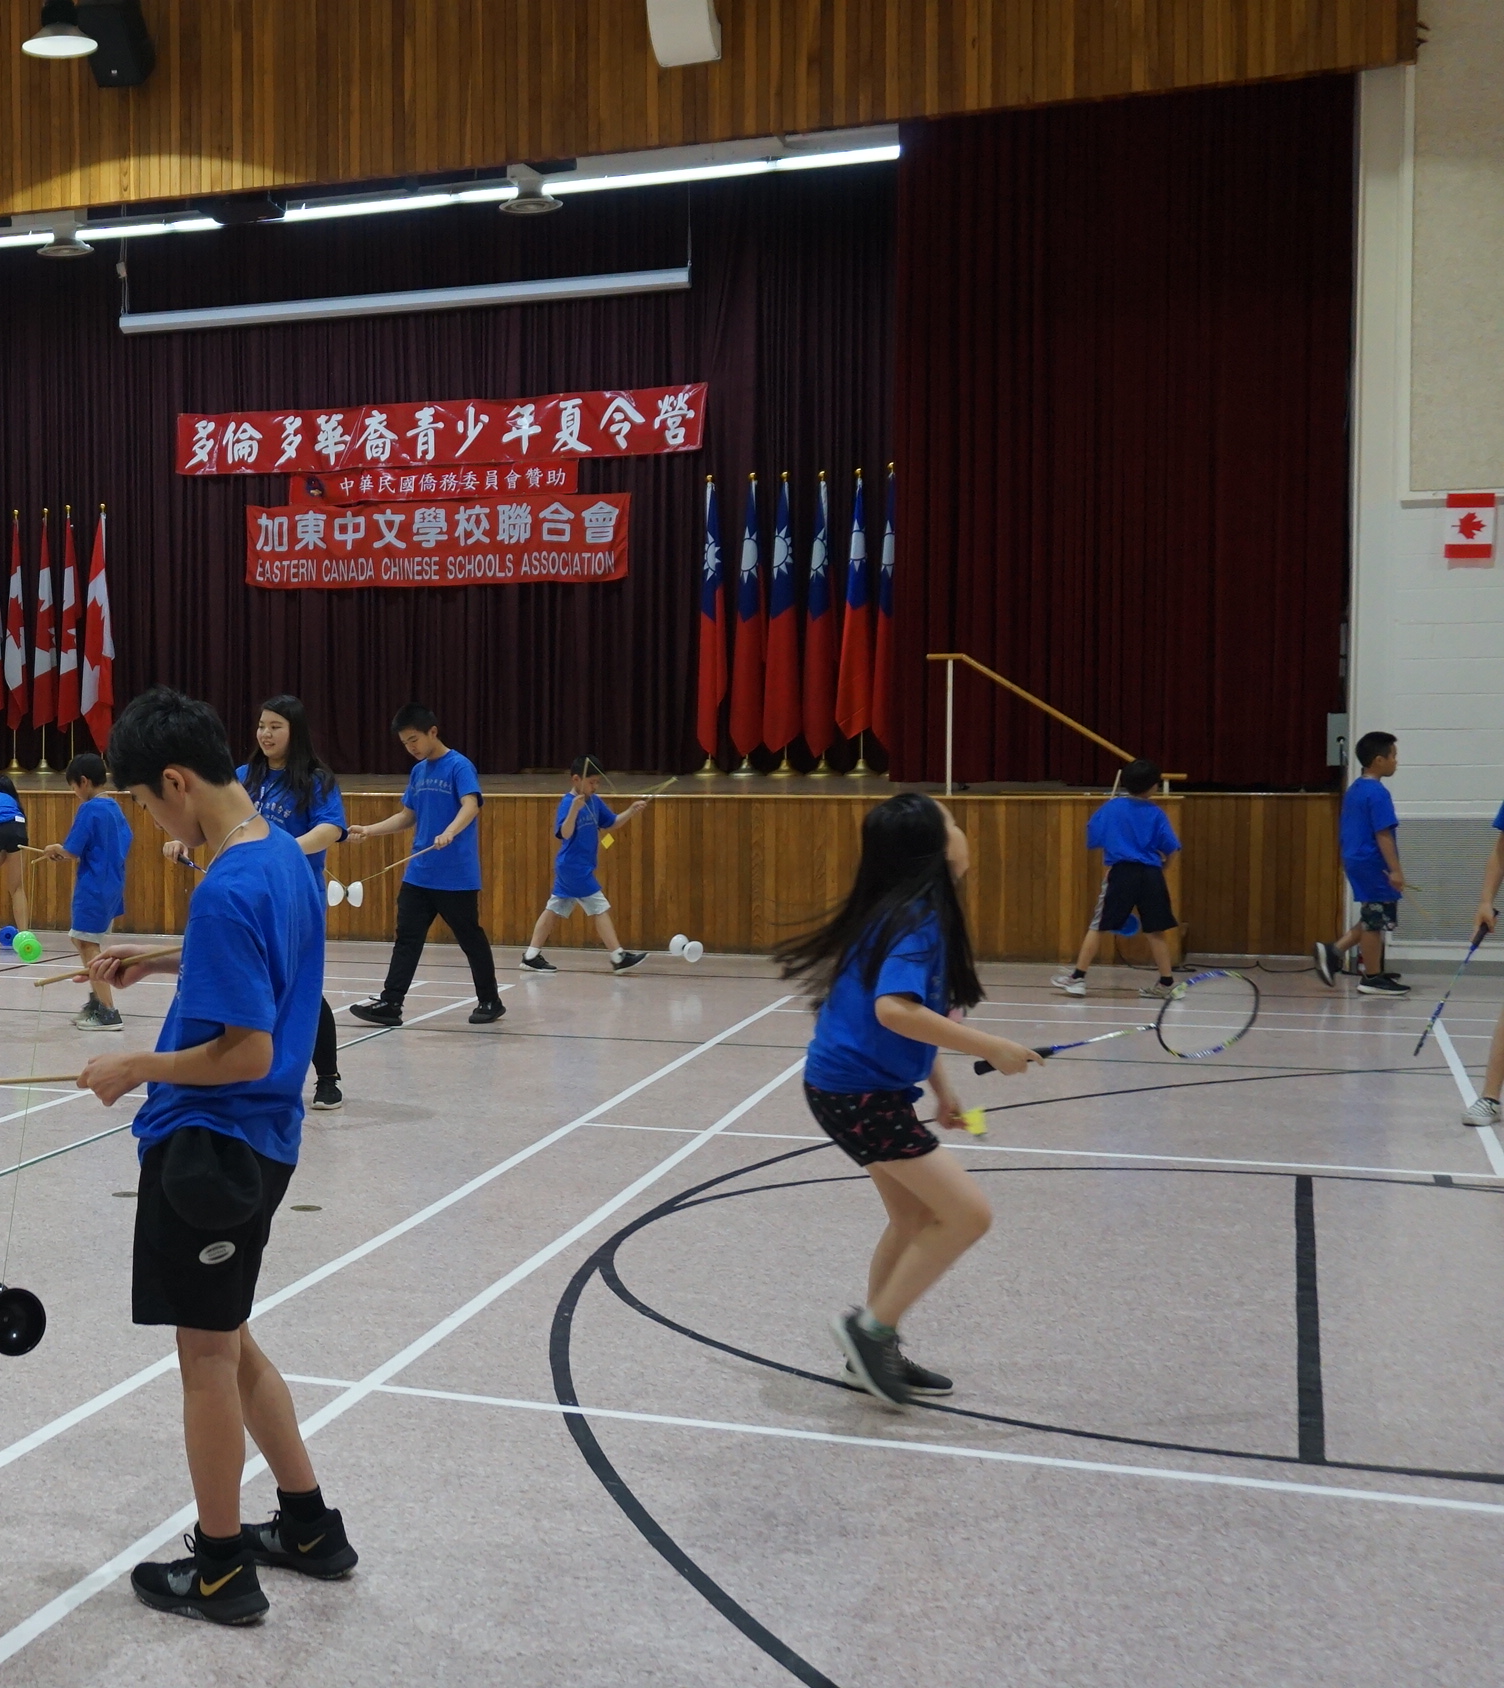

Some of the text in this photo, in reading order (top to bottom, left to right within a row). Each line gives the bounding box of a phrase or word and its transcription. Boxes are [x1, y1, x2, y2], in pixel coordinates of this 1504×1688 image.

[185, 394, 695, 468] 多倫多華裔青少年夏令營
[256, 501, 619, 552] 加東中文學校聯合會
[256, 551, 615, 583] EASTERN CANADA CHINESE SCHOOLS ASSOCIATION
